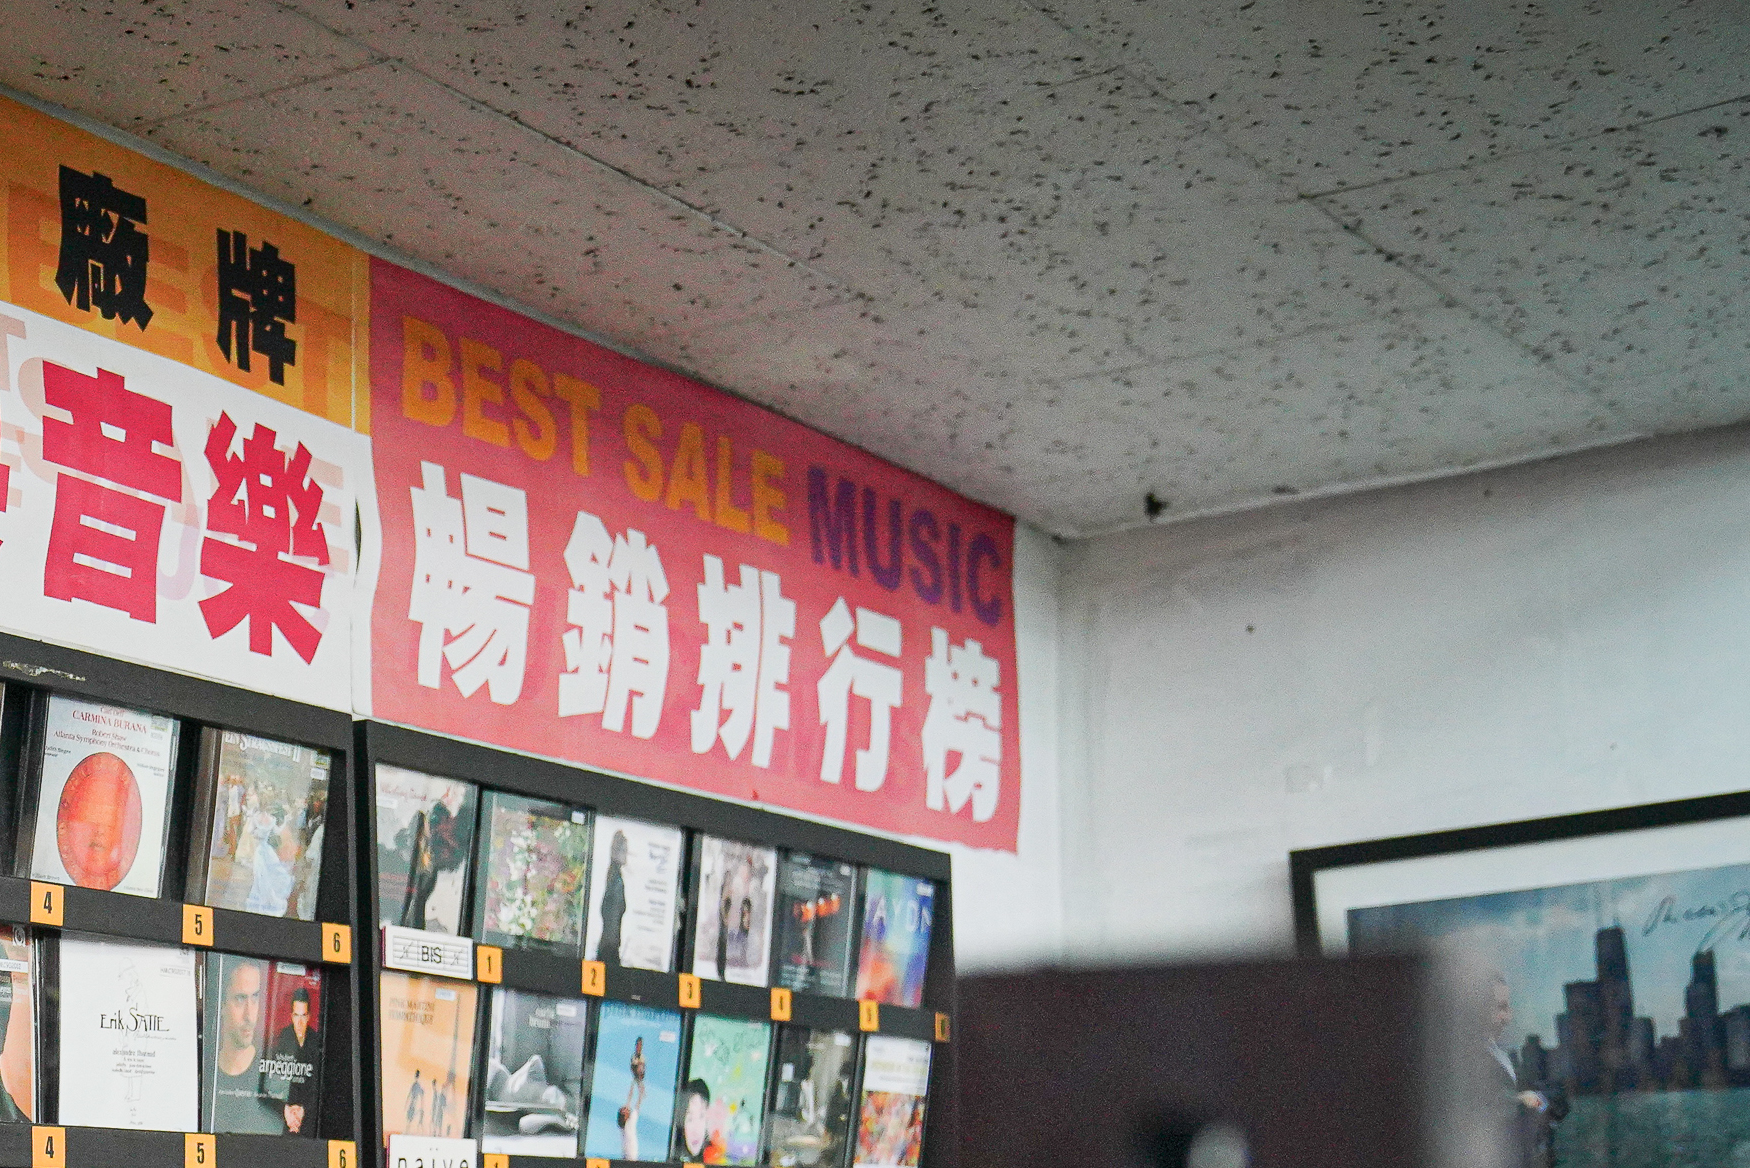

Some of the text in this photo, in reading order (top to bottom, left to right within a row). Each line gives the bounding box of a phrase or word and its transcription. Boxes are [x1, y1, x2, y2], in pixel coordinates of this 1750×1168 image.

[402, 315, 1002, 626] BEST SALE MUSIC
[408, 461, 1002, 822] 暢銷排行榜
[72, 709, 147, 735] CARMINA BURANA
[43, 891, 53, 914] 4
[194, 913, 203, 936] 5
[333, 931, 341, 953] 6
[421, 945, 443, 964] BIS
[590, 968, 597, 986] 2
[100, 1009, 124, 1031] Erik
[258, 1058, 313, 1082] arpeggione
[45, 1137, 54, 1158] 4
[196, 1143, 205, 1164] 5
[339, 1150, 347, 1168] 6
